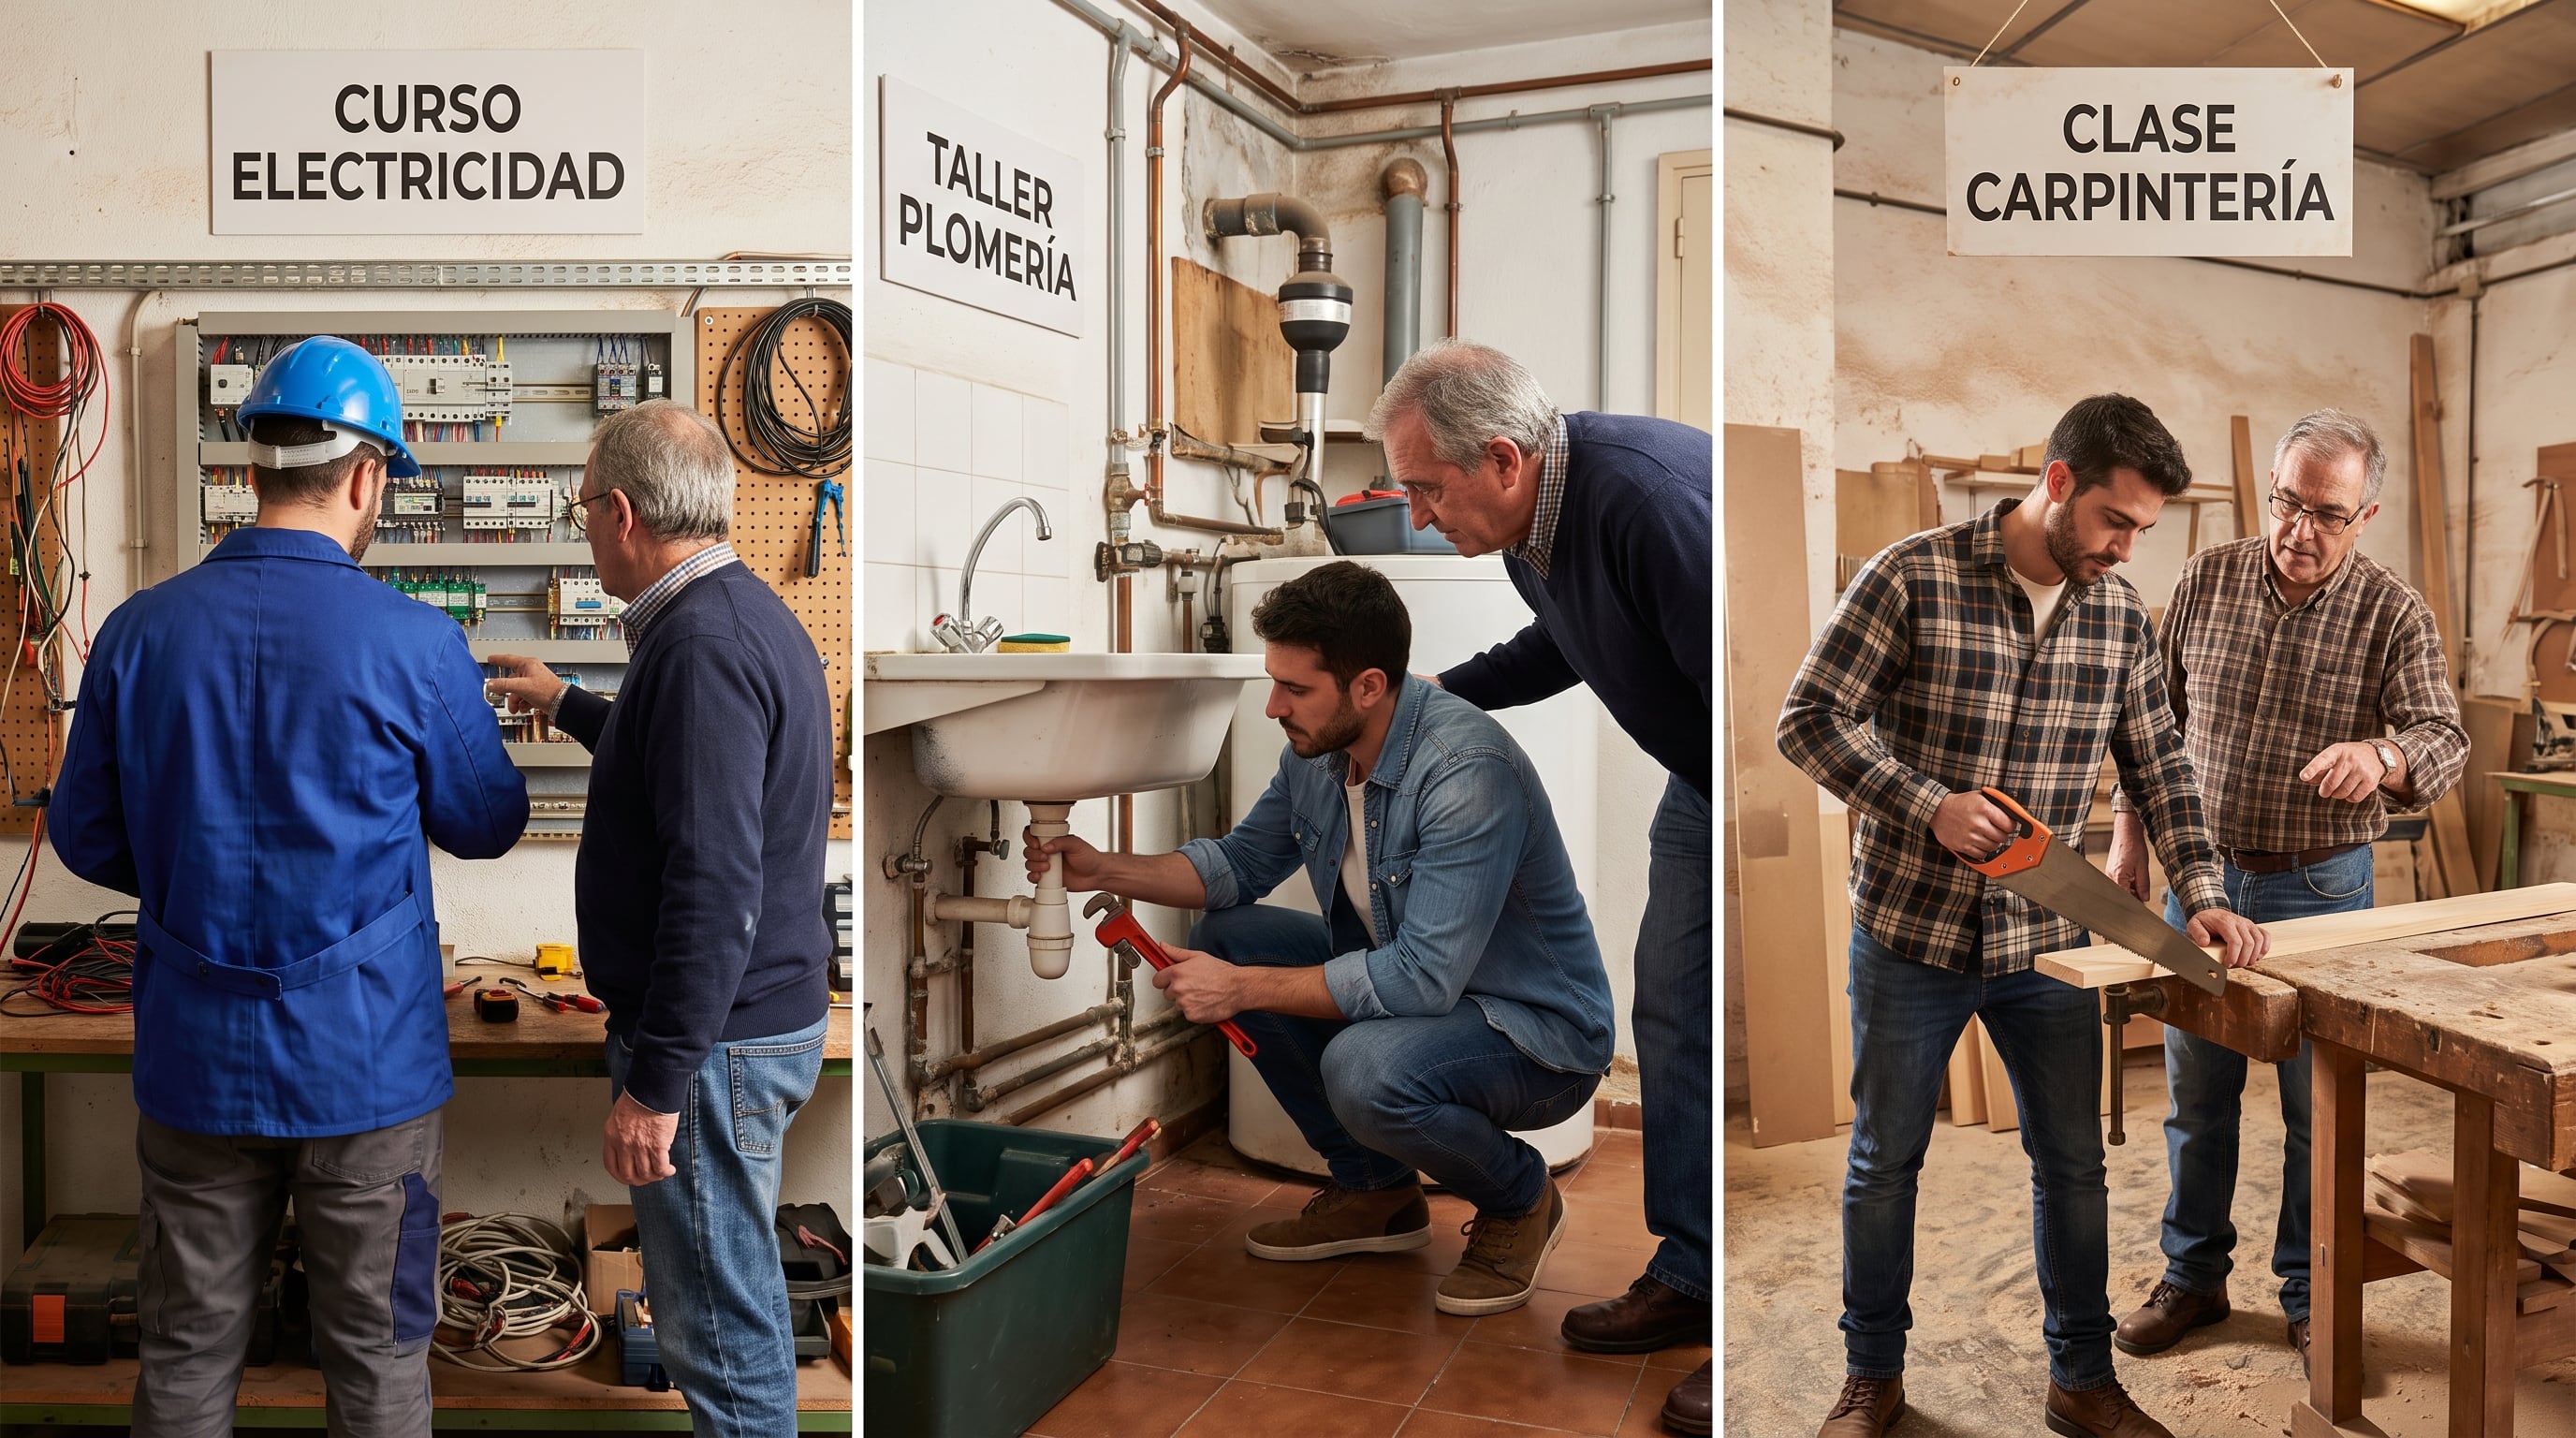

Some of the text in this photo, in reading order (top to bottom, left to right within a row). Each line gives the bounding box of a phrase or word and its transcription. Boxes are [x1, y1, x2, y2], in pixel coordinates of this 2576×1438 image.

[334, 83, 521, 134] CURSO
[2063, 103, 2236, 154] CLASE
[233, 151, 625, 201] ELECTRICIDAD
[927, 131, 1053, 228] TALLER
[1966, 157, 2335, 222] CARPINTERÍA
[900, 193, 1076, 301] PLOMERÍA
